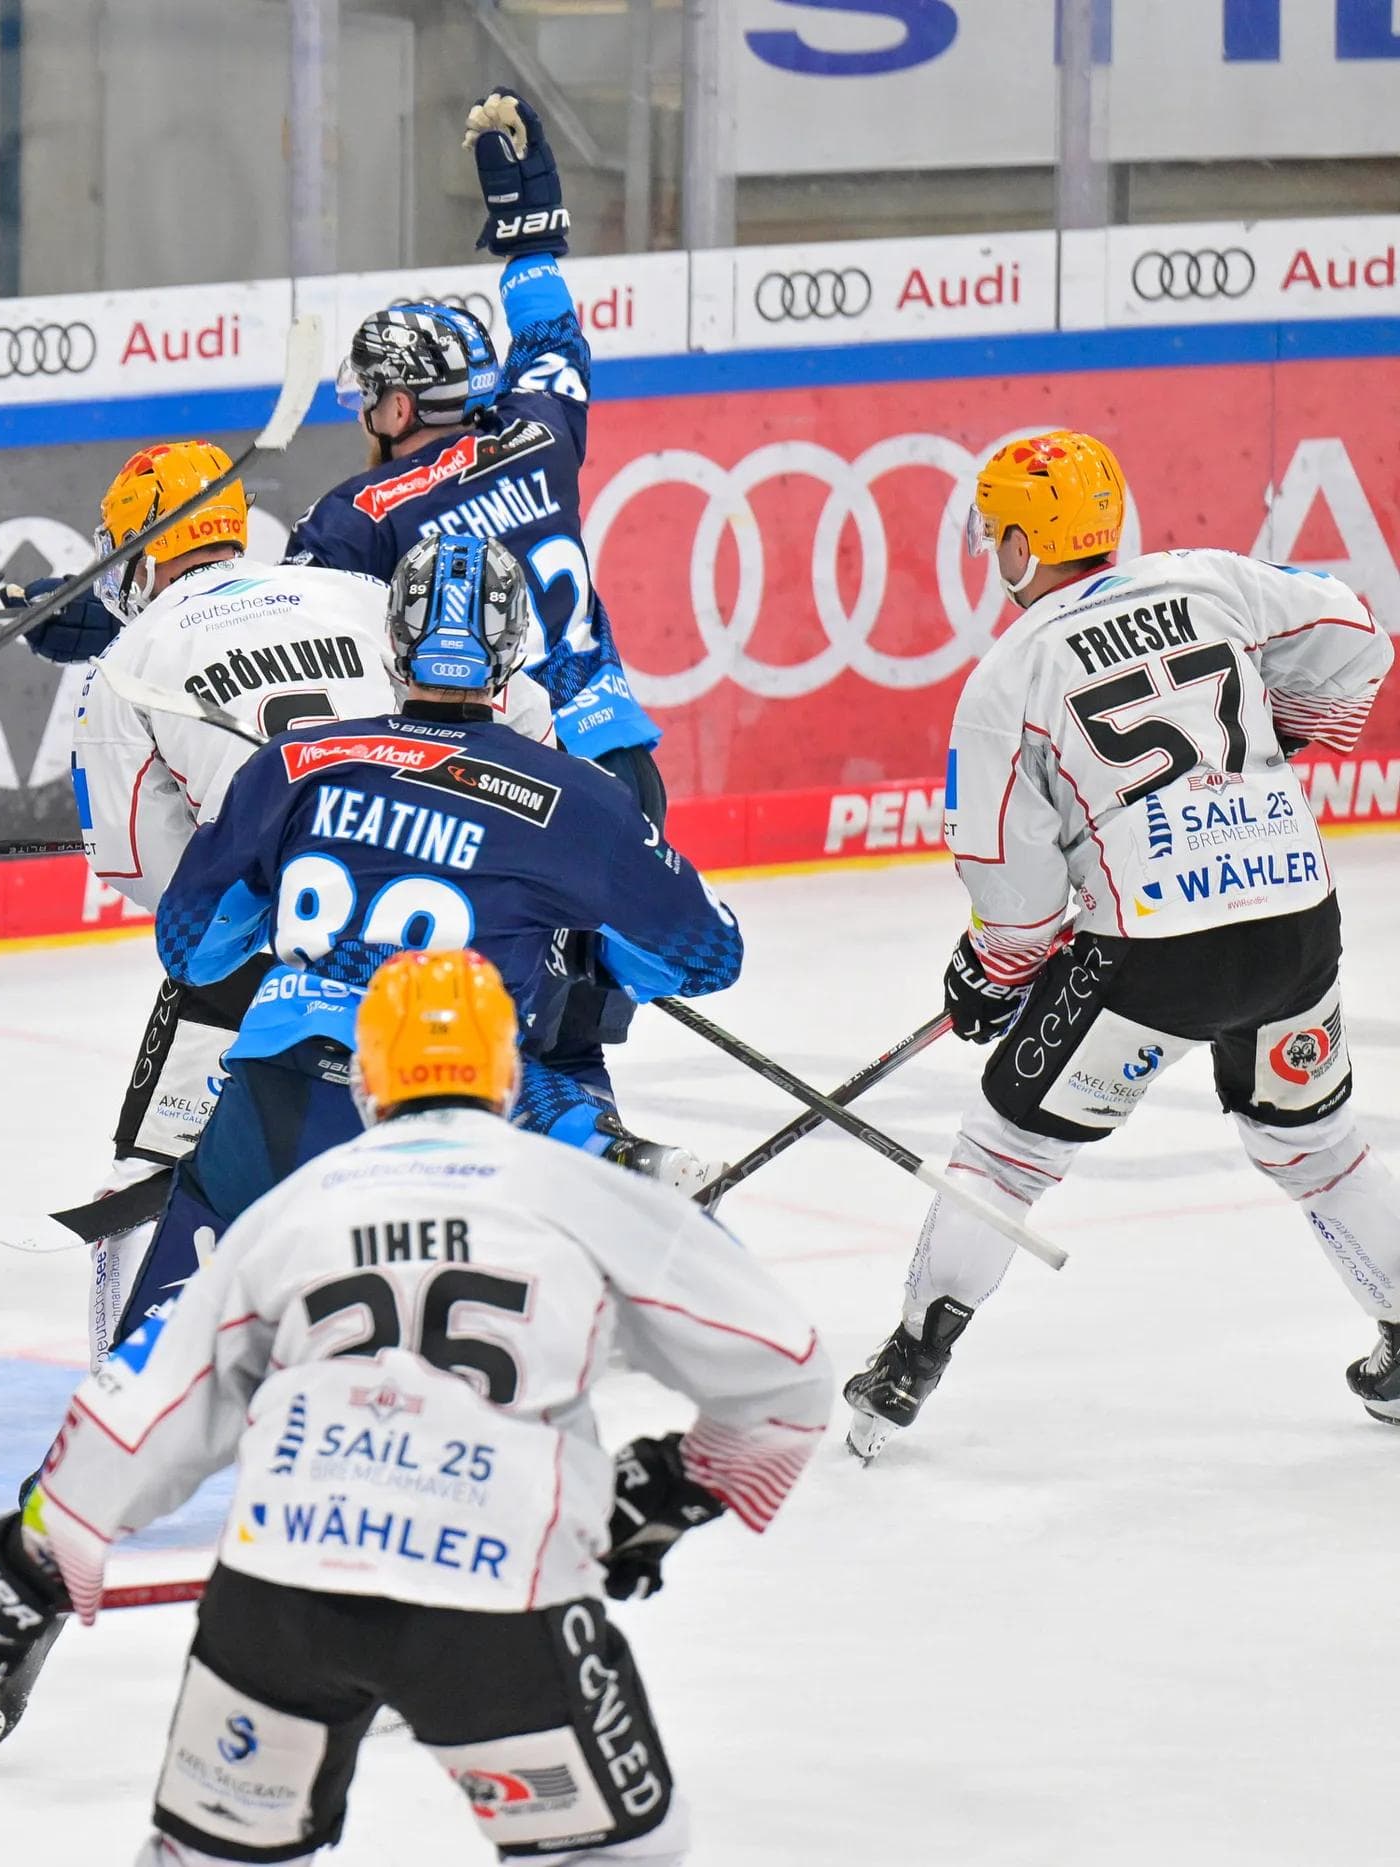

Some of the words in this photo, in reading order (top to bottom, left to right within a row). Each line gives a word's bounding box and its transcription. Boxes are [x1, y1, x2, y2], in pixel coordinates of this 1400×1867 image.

[496, 209, 571, 239] UER
[1281, 245, 1396, 291] Aud
[897, 263, 1020, 309] Audi
[122, 315, 241, 365] Audi
[188, 519, 242, 540] LOTTO
[409, 583, 427, 595] 89
[489, 591, 507, 603] 89
[204, 606, 293, 633] Fischmanufaktur
[1066, 597, 1198, 675] FRIESEN
[183, 636, 365, 709] GRÖNLUND
[400, 724, 467, 741] BAUER
[1064, 638, 1249, 807] 57
[478, 774, 545, 811] SATURN
[1205, 774, 1224, 787] 40
[824, 789, 945, 853] PEN
[1266, 791, 1294, 819] 25
[310, 786, 486, 871] KEATING
[1186, 818, 1299, 851] BREMERHAVEN
[1176, 851, 1320, 902] WÄHLER
[318, 1058, 353, 1074] BAU
[399, 1064, 478, 1085] LOTTO
[1072, 1071, 1105, 1091] AXEL
[156, 1107, 181, 1120] YACHT
[158, 1095, 192, 1112] AXEL
[351, 1217, 469, 1268] UHER
[943, 1302, 969, 1319] CCM
[300, 1261, 537, 1409] 26
[440, 1440, 495, 1482] 25
[310, 1458, 488, 1506] BREMERHAVEN
[283, 1494, 509, 1580] WÄHLER
